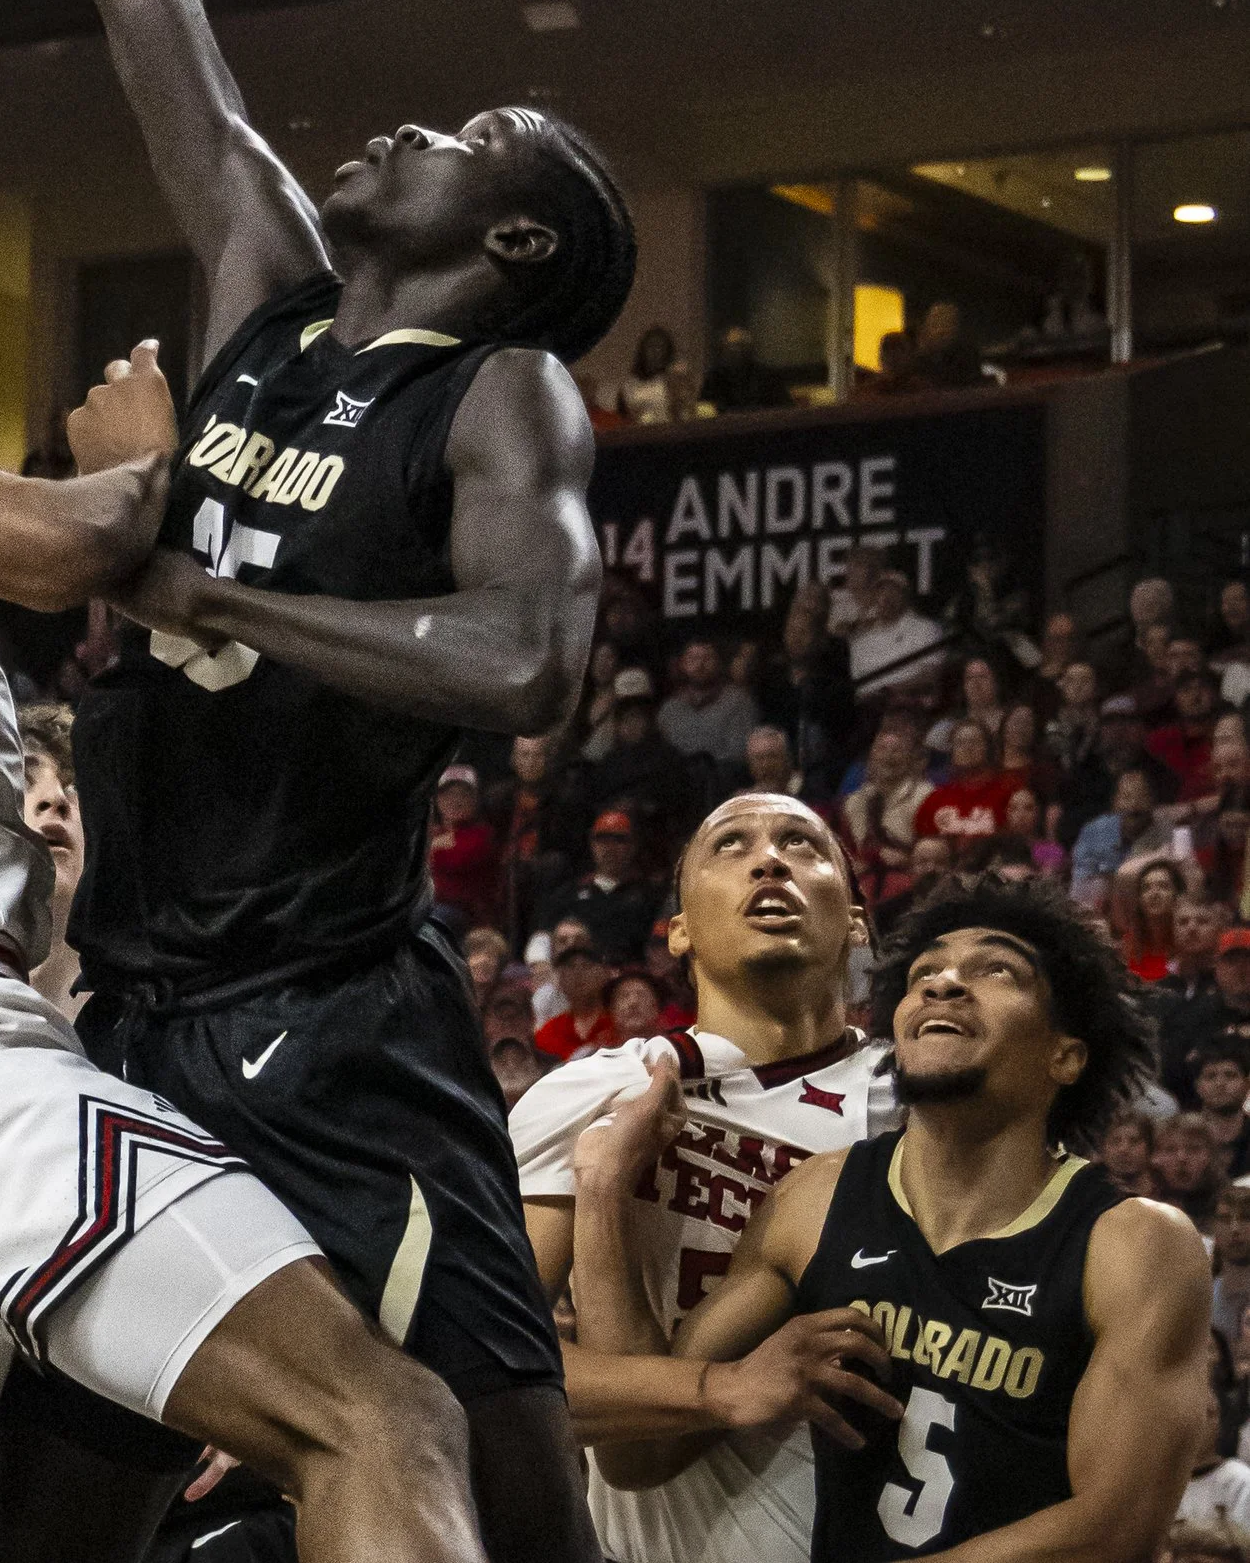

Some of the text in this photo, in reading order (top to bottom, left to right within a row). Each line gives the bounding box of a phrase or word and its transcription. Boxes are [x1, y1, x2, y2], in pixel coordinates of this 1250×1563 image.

[665, 455, 897, 544] ANDRE
[601, 517, 654, 583] 14
[876, 1386, 956, 1548] 5
